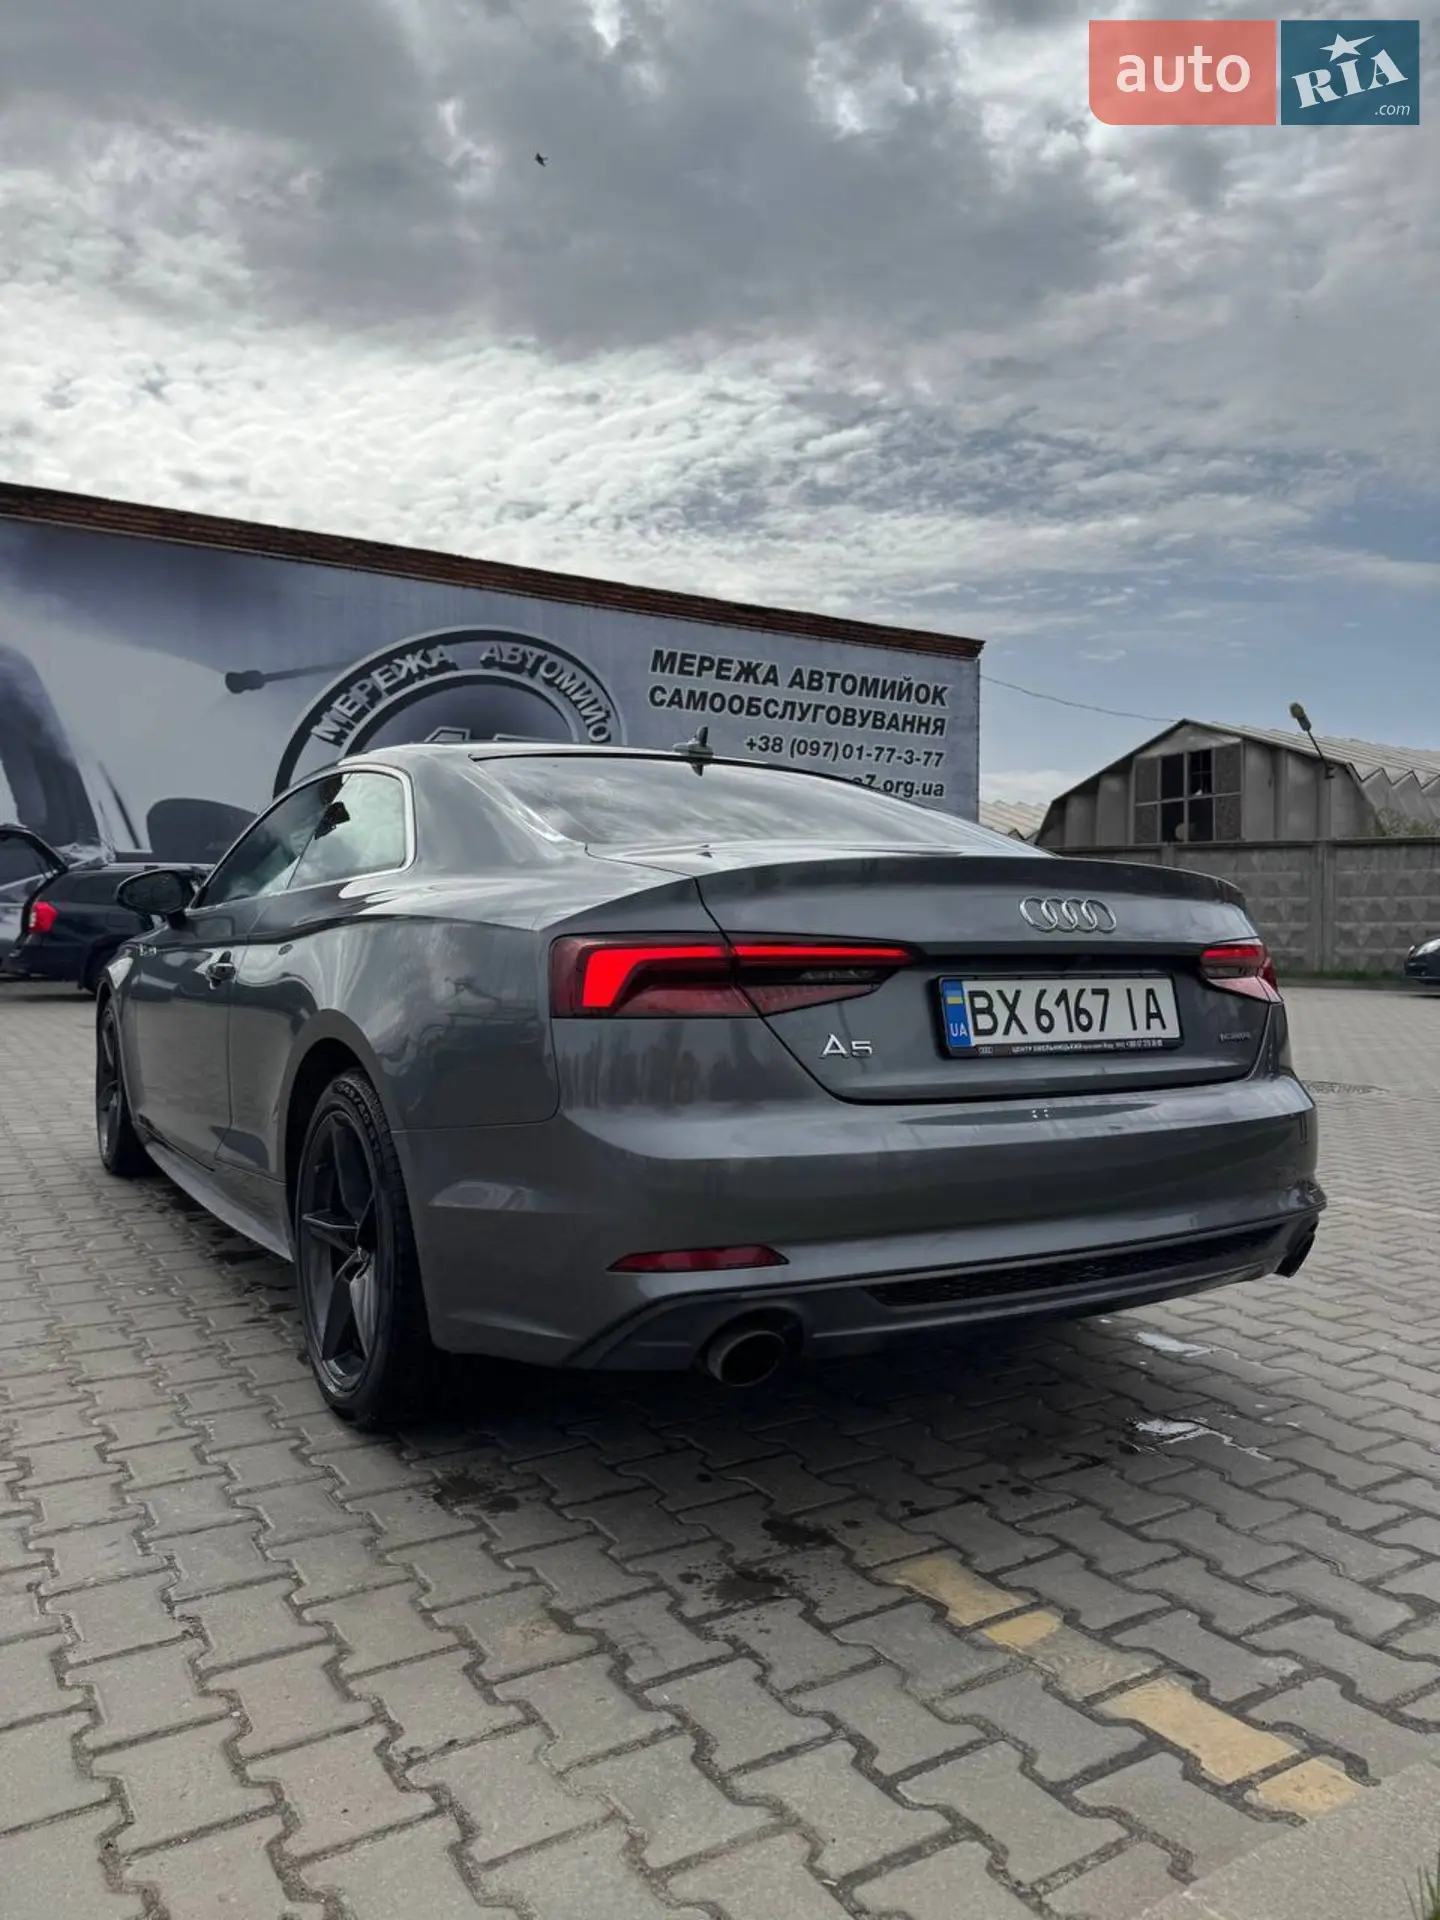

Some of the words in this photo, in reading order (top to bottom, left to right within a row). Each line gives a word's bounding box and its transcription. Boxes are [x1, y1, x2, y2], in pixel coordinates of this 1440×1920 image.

[311, 644, 454, 743] МЕРЕЖА
[650, 649, 779, 687] МЕРЕЖА
[787, 667, 949, 706] АВТОМИЙОК
[648, 685, 946, 737] САМООБСЛУГОВУВАННЯ
[746, 735, 783, 754] +38
[950, 1022, 968, 1037] UA
[968, 988, 1028, 1037] BX
[1034, 988, 1110, 1034] 6167
[1126, 987, 1167, 1031] IA
[819, 1033, 873, 1058] A5
